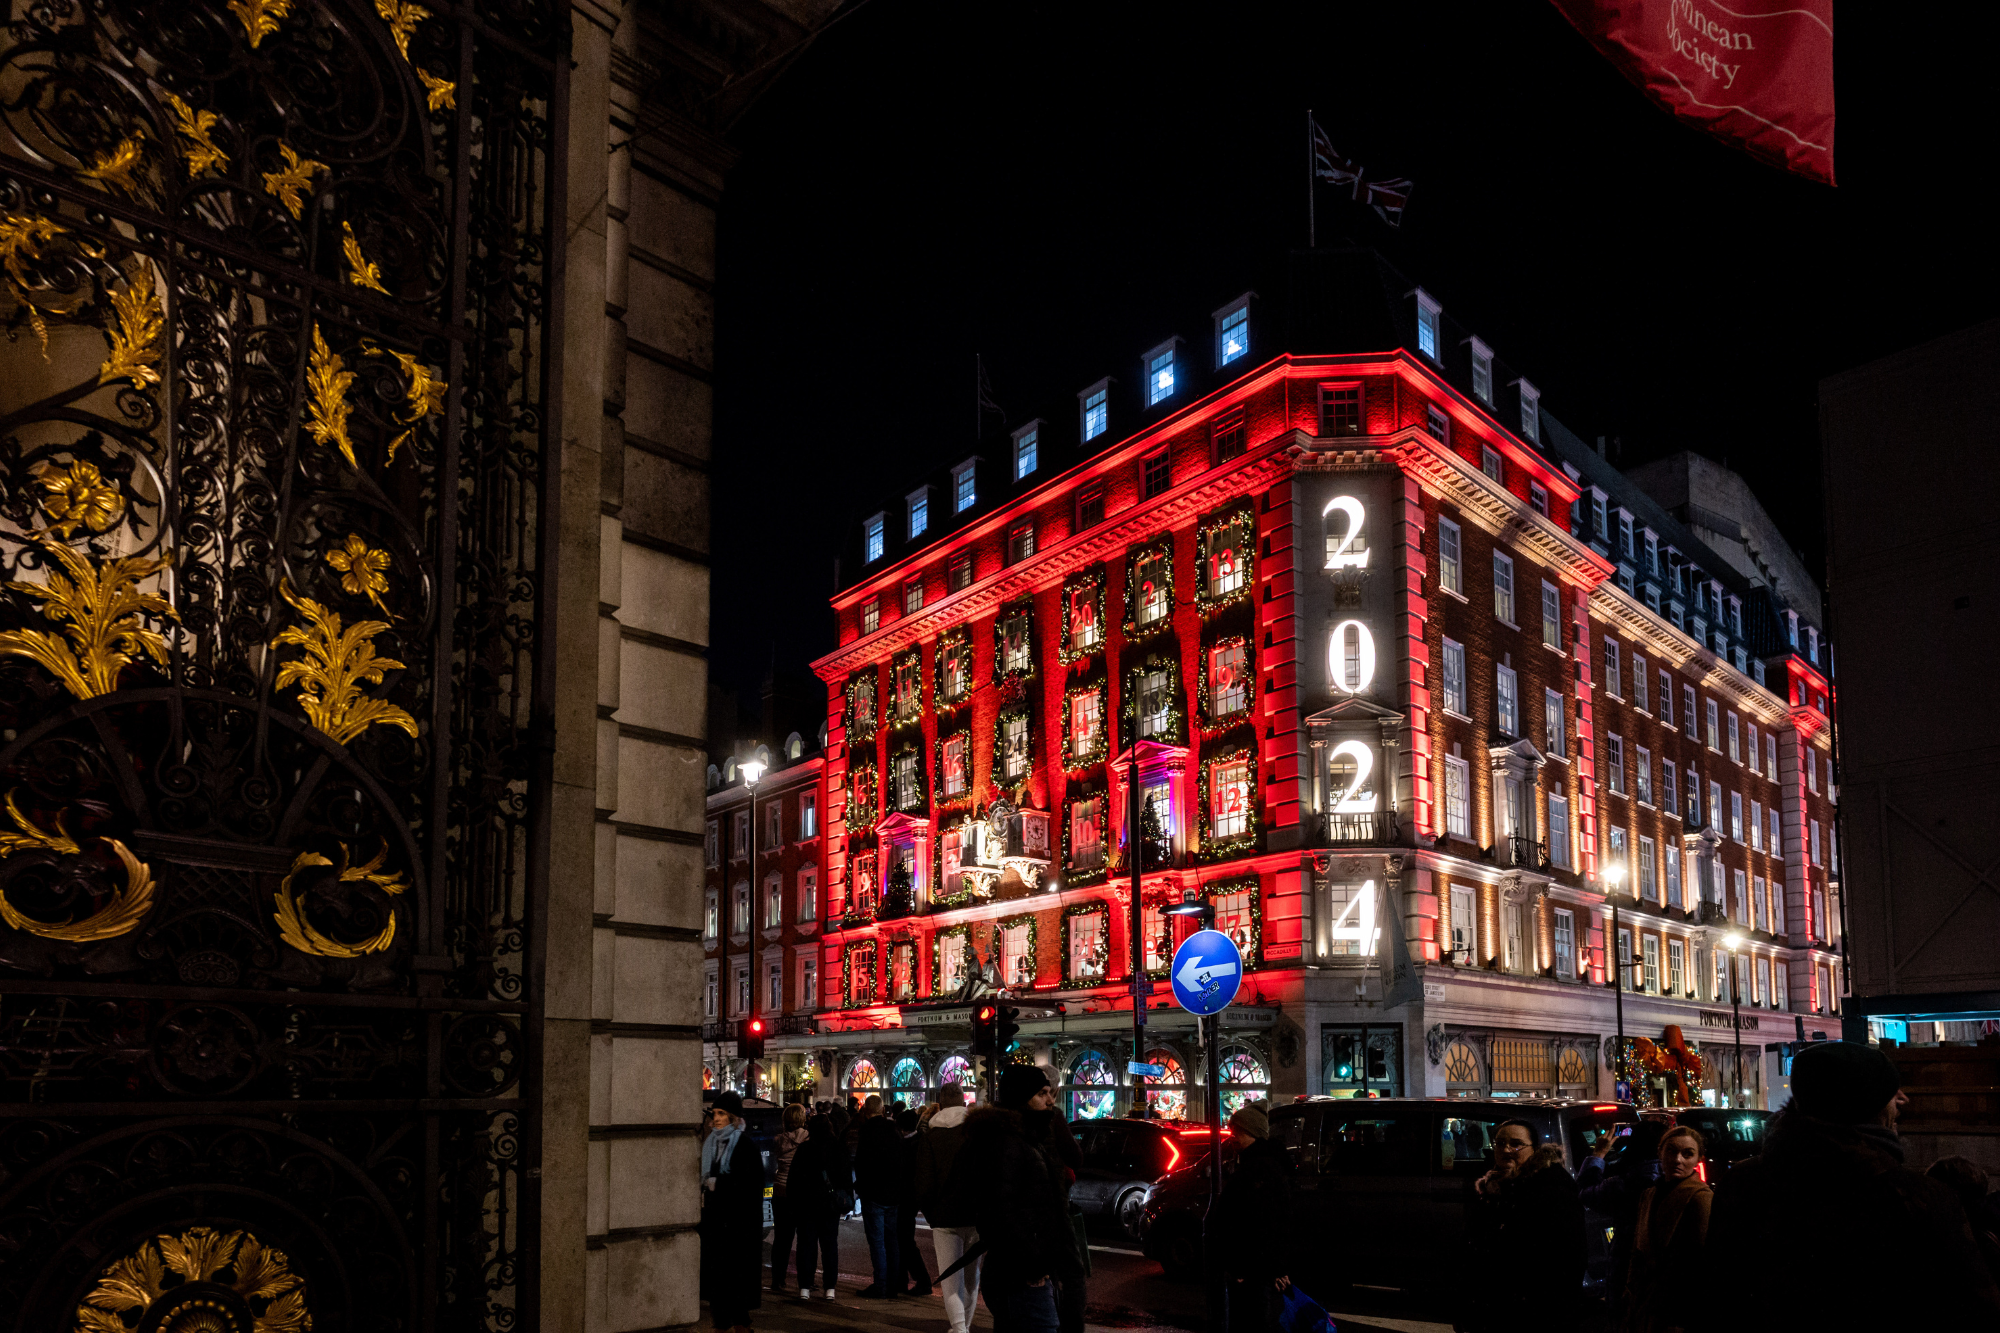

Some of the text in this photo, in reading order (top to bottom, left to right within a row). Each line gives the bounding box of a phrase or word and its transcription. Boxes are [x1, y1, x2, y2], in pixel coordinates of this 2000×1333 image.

[1667, 0, 1741, 89] Society
[1209, 548, 1235, 580] 13
[1142, 580, 1156, 606] 2
[1070, 604, 1093, 634] 20
[948, 658, 958, 681] 7
[1004, 734, 1023, 759] 24
[1216, 787, 1242, 815] 12
[1266, 948, 1292, 956] PICCADILLY
[852, 967, 868, 987] 15
[1699, 1010, 1732, 1029] FORTNUM
